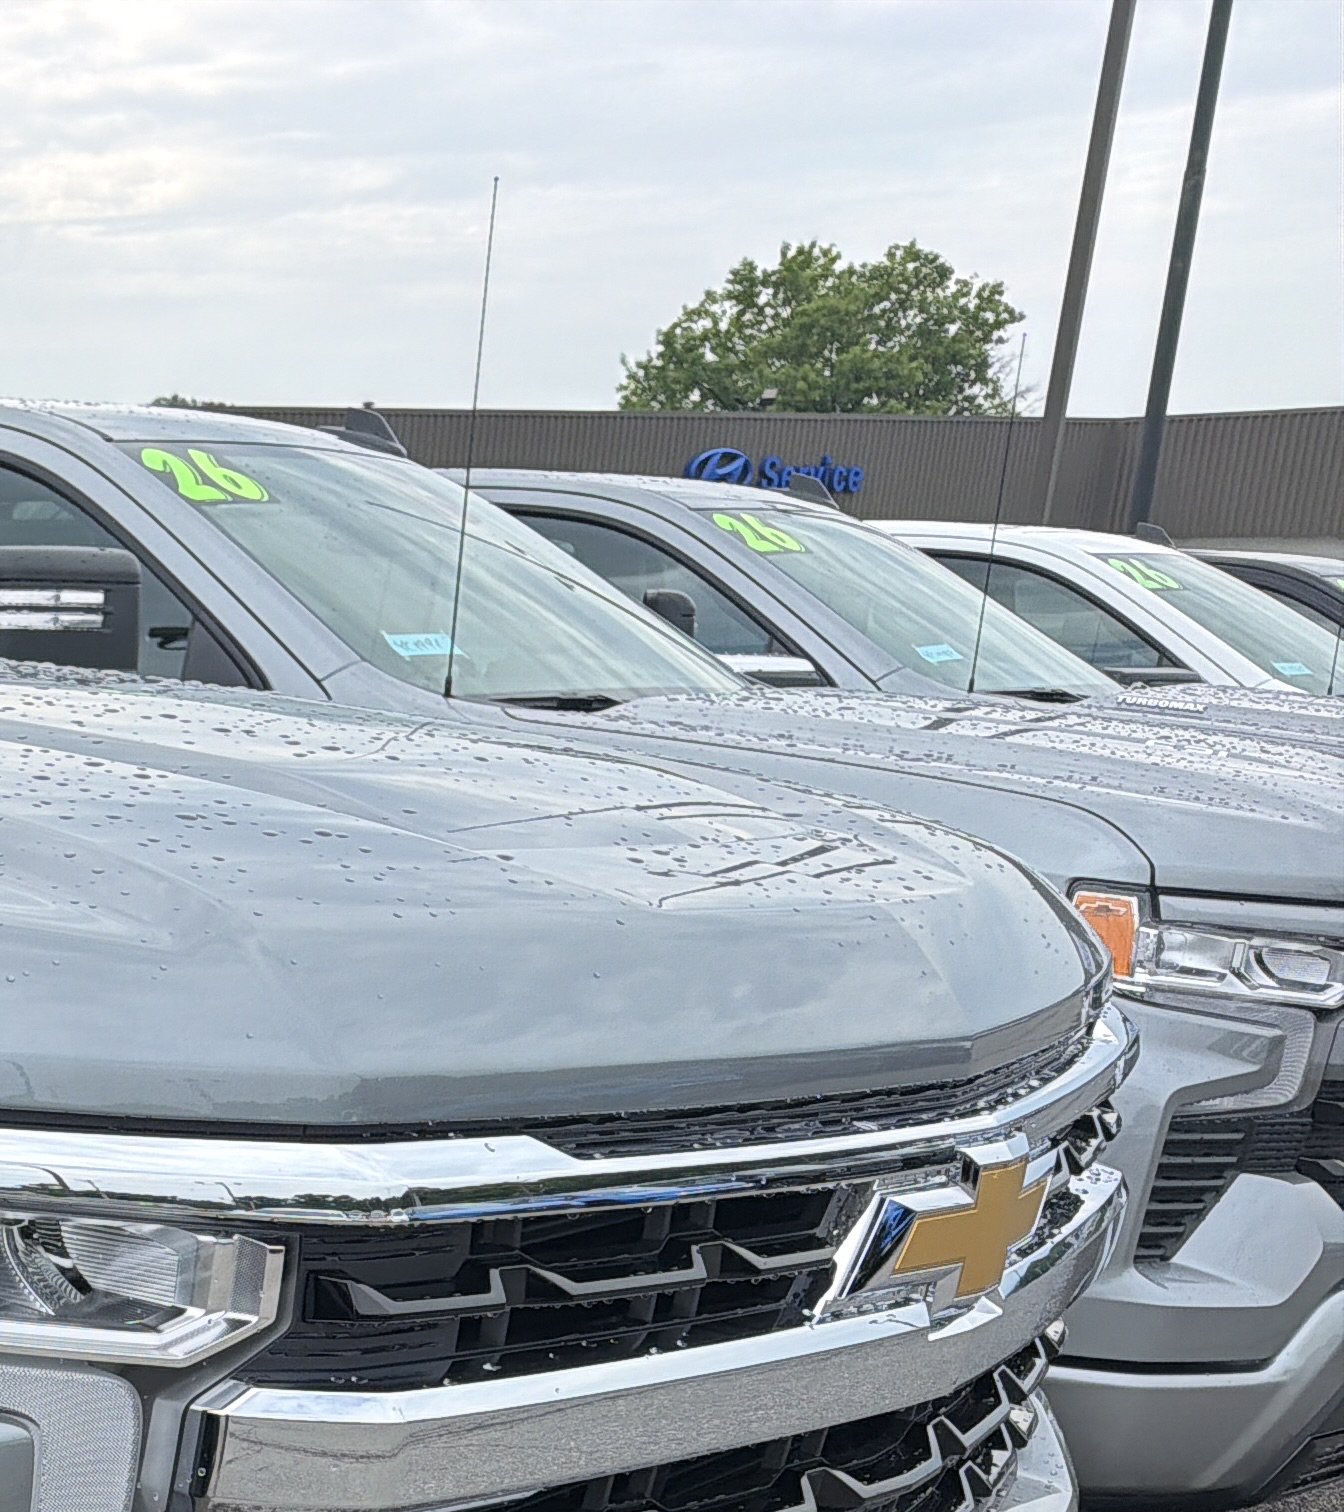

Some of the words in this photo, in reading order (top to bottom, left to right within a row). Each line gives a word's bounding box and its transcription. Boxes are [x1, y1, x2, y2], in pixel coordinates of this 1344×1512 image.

[141, 448, 270, 503] 26
[713, 513, 805, 552] 26
[1108, 558, 1183, 590] 26
[1117, 695, 1208, 714] TURBOMAX
